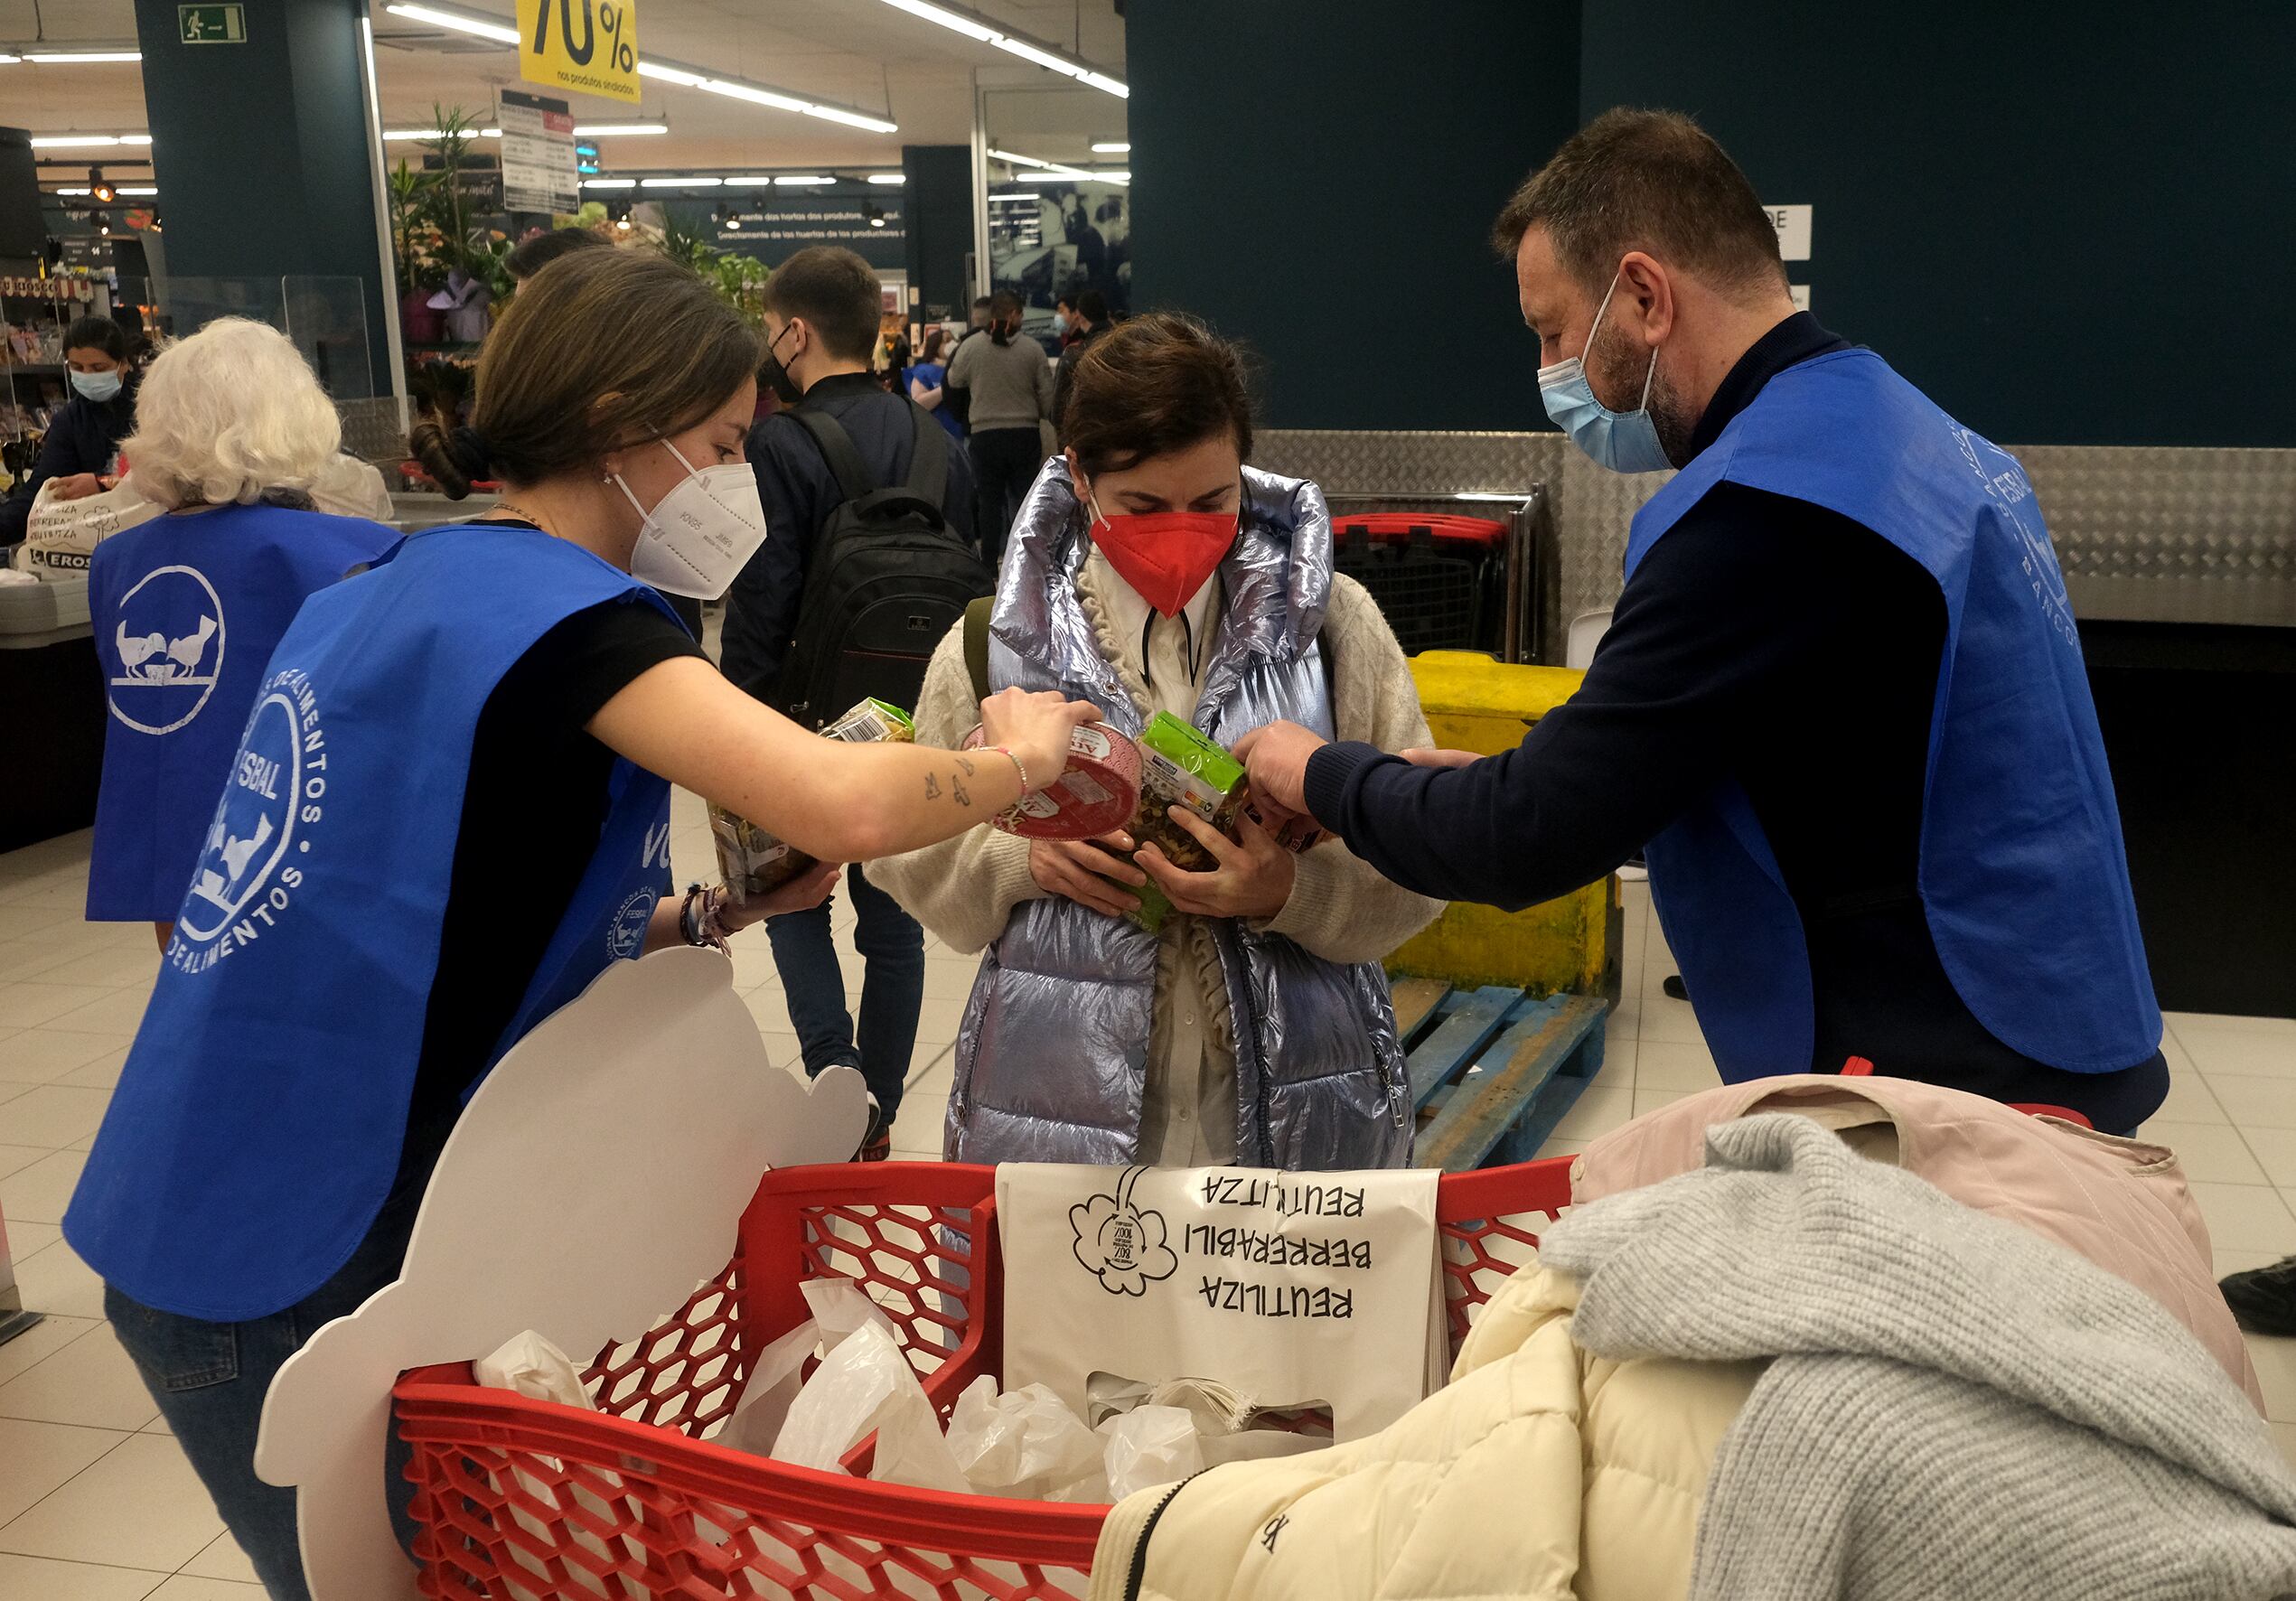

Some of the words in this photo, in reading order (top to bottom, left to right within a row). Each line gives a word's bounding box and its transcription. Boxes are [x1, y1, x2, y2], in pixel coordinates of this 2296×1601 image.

[1201, 1176, 1364, 1217] REUTILITZA
[1185, 1223, 1372, 1269] BERRERABILI
[1198, 1275, 1354, 1318] REUTILIZA
